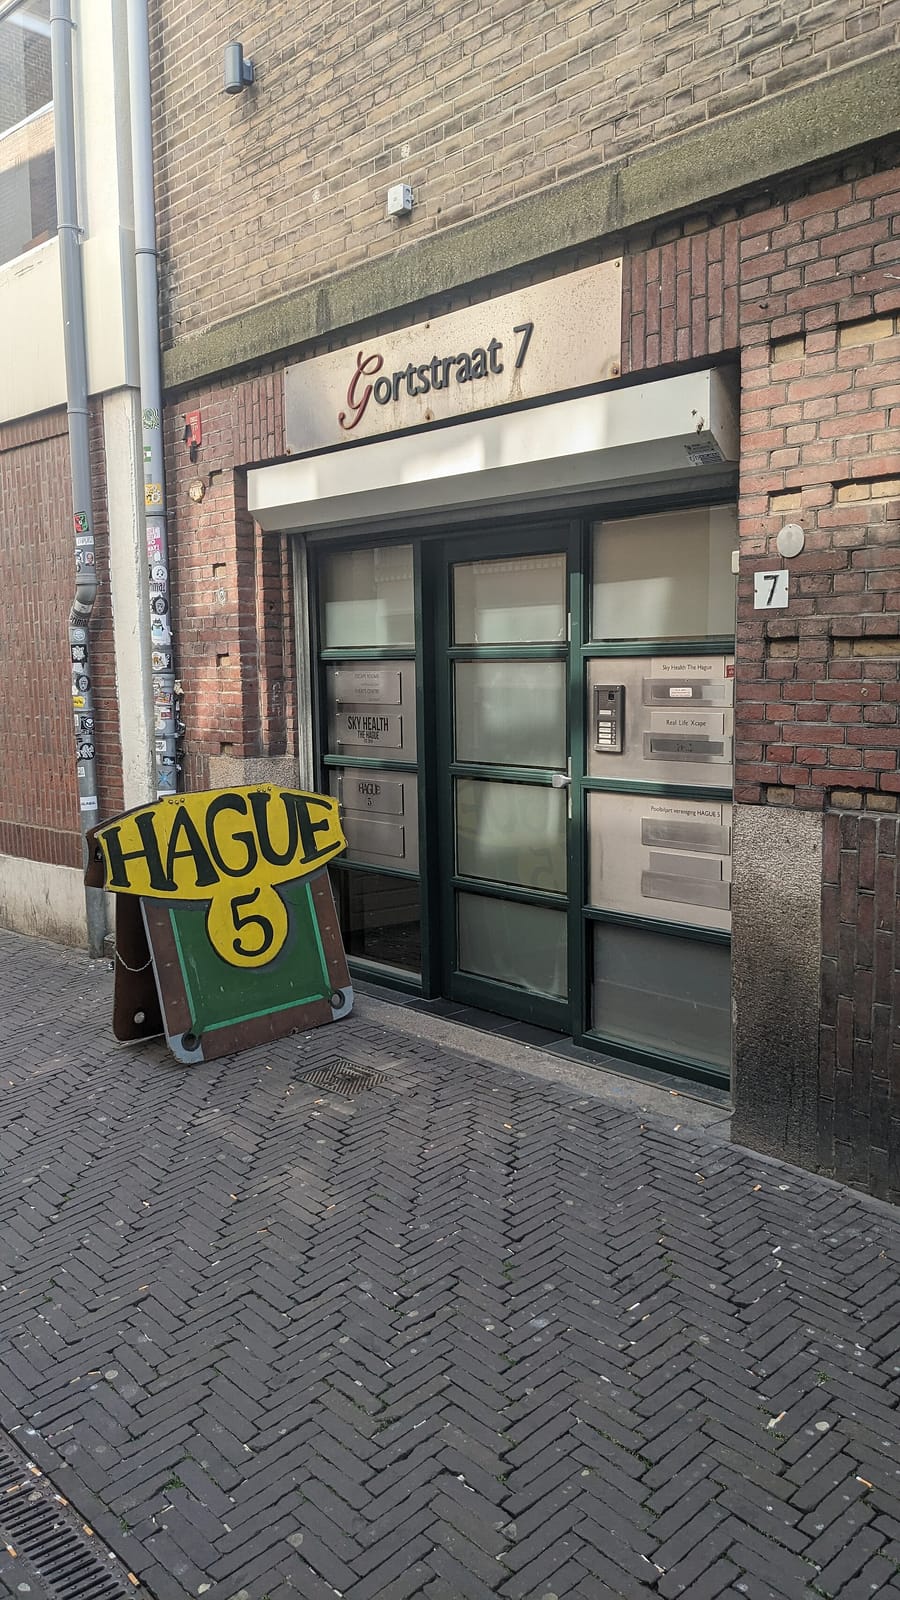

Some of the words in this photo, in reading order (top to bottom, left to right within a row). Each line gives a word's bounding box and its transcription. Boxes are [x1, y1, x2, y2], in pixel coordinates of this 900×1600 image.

[338, 337, 504, 430] Gortstraat
[513, 321, 534, 369] 7
[763, 574, 780, 606] 7
[662, 664, 670, 672] Sky
[697, 664, 712, 672] Hague
[347, 715, 362, 730] SKY
[362, 716, 389, 732] HEALTH
[690, 719, 707, 727] Xcape
[357, 730, 365, 739] THE
[366, 731, 380, 740] HAGUE
[358, 783, 381, 796] HAGUE
[367, 797, 373, 806] 5
[697, 809, 716, 817] HAGUE
[101, 792, 341, 892] HAGUE
[230, 887, 274, 957] 5
